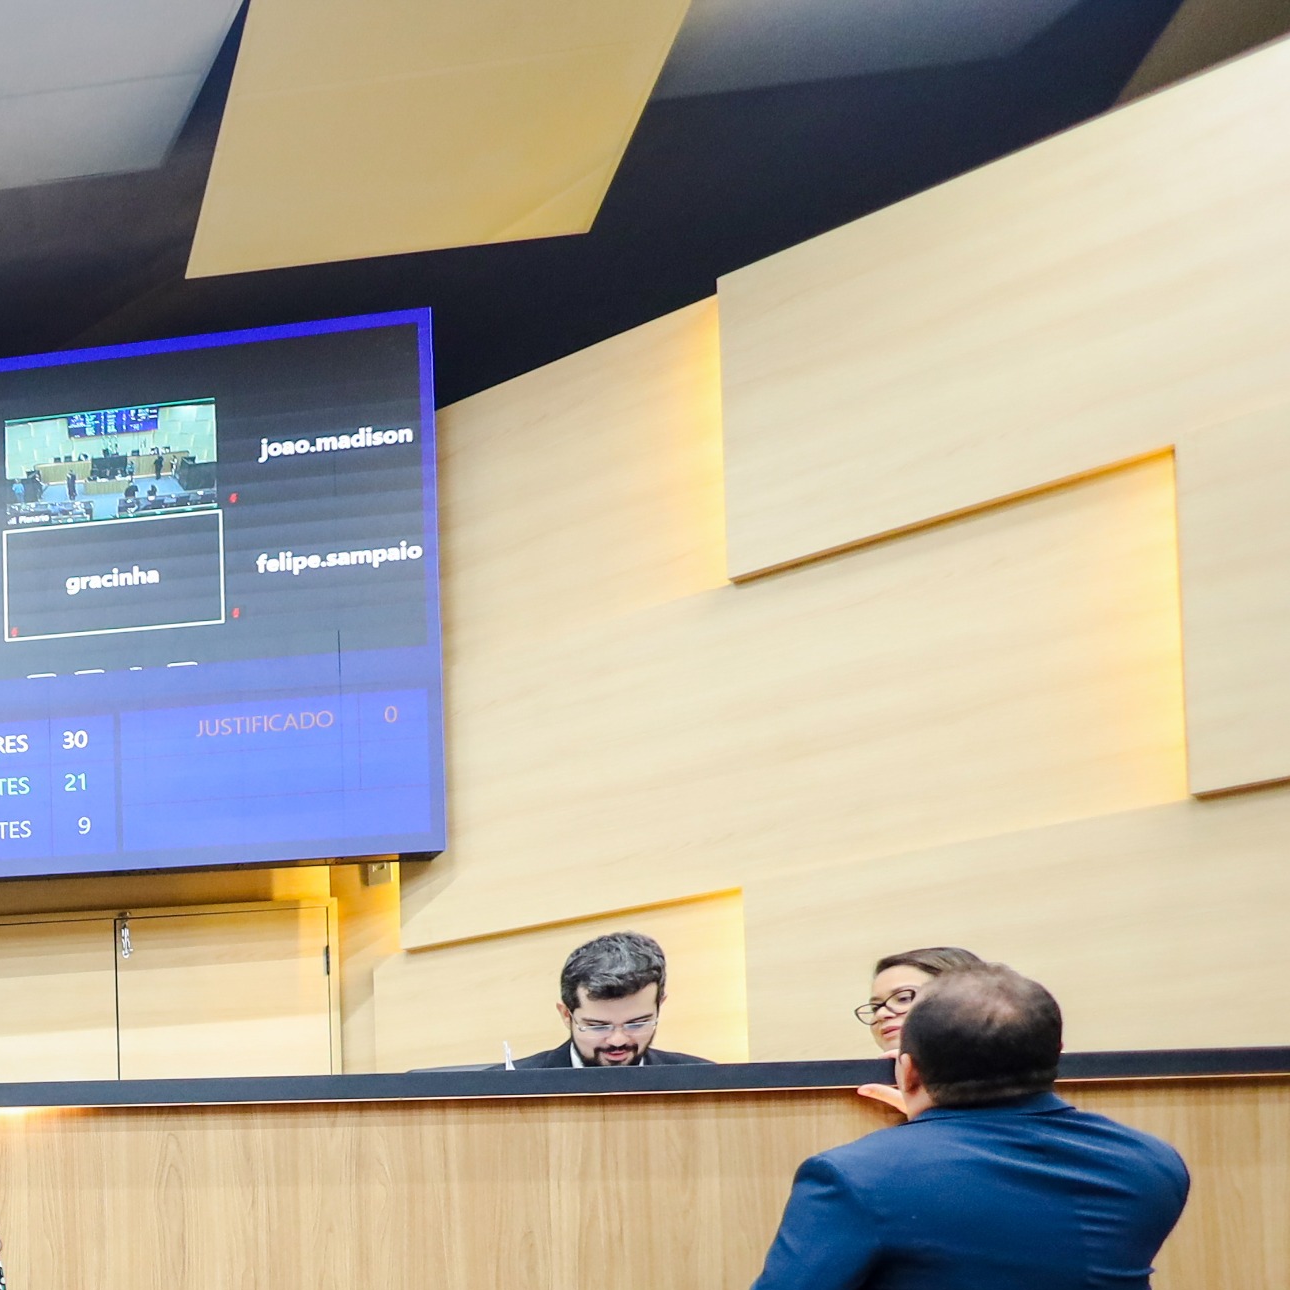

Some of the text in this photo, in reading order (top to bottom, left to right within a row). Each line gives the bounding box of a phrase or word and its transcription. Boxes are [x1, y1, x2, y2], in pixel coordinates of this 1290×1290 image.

[257, 426, 414, 464] joao.madison
[255, 540, 423, 576] felipe.sampaio
[66, 565, 160, 595] gracinha
[196, 710, 335, 737] JUSTIFICADO
[384, 705, 399, 723] 0
[63, 730, 88, 750] 30
[64, 773, 86, 792] 21
[78, 816, 91, 834] 9
